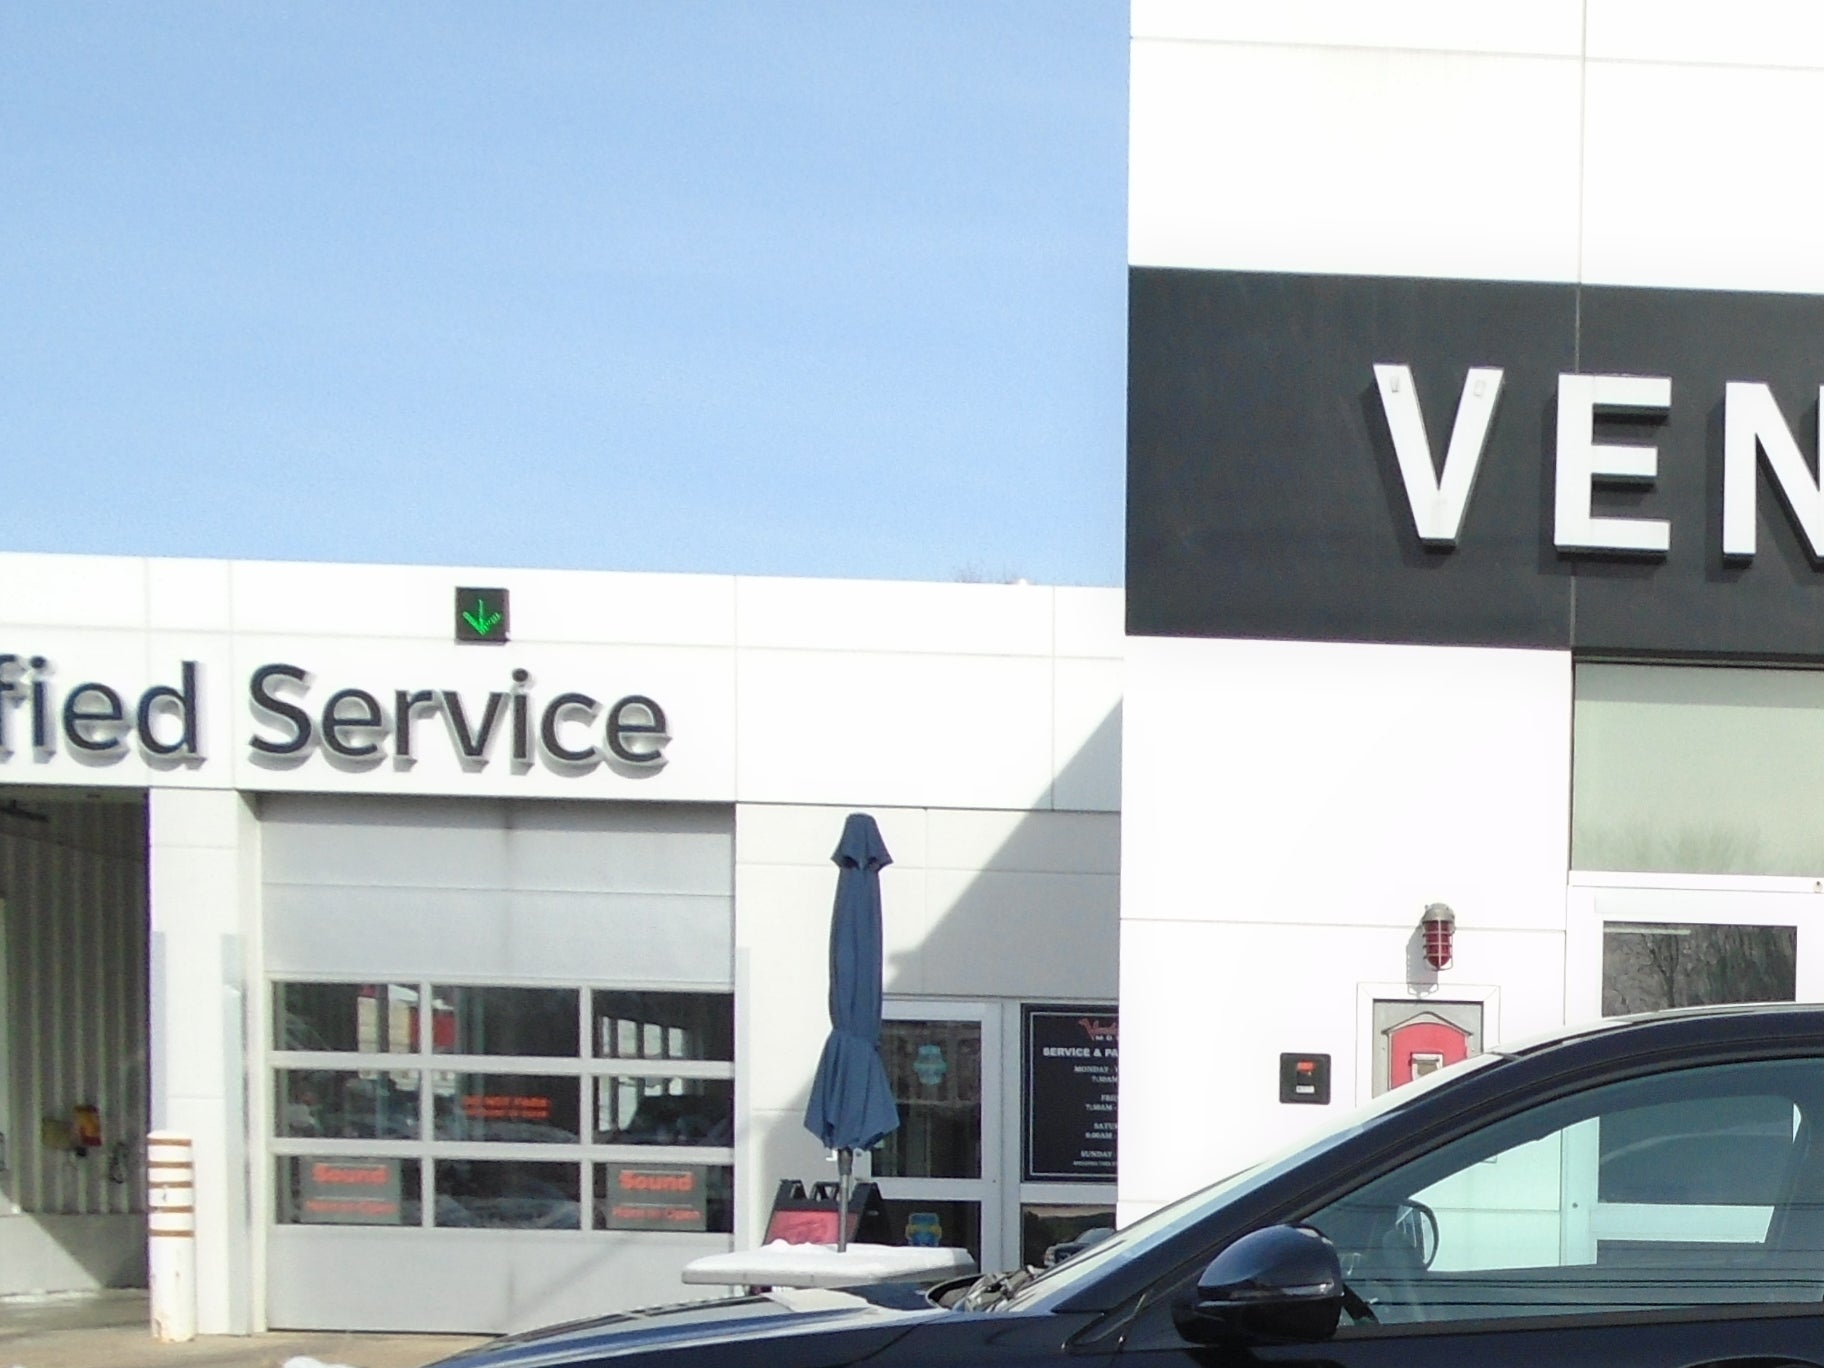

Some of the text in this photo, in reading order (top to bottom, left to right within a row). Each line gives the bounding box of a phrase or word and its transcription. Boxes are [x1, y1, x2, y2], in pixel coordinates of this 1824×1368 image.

[248, 662, 674, 774] Service
[1042, 1047, 1091, 1058] SERVICE
[312, 1163, 389, 1185] Sound
[618, 1170, 694, 1191] Sound
